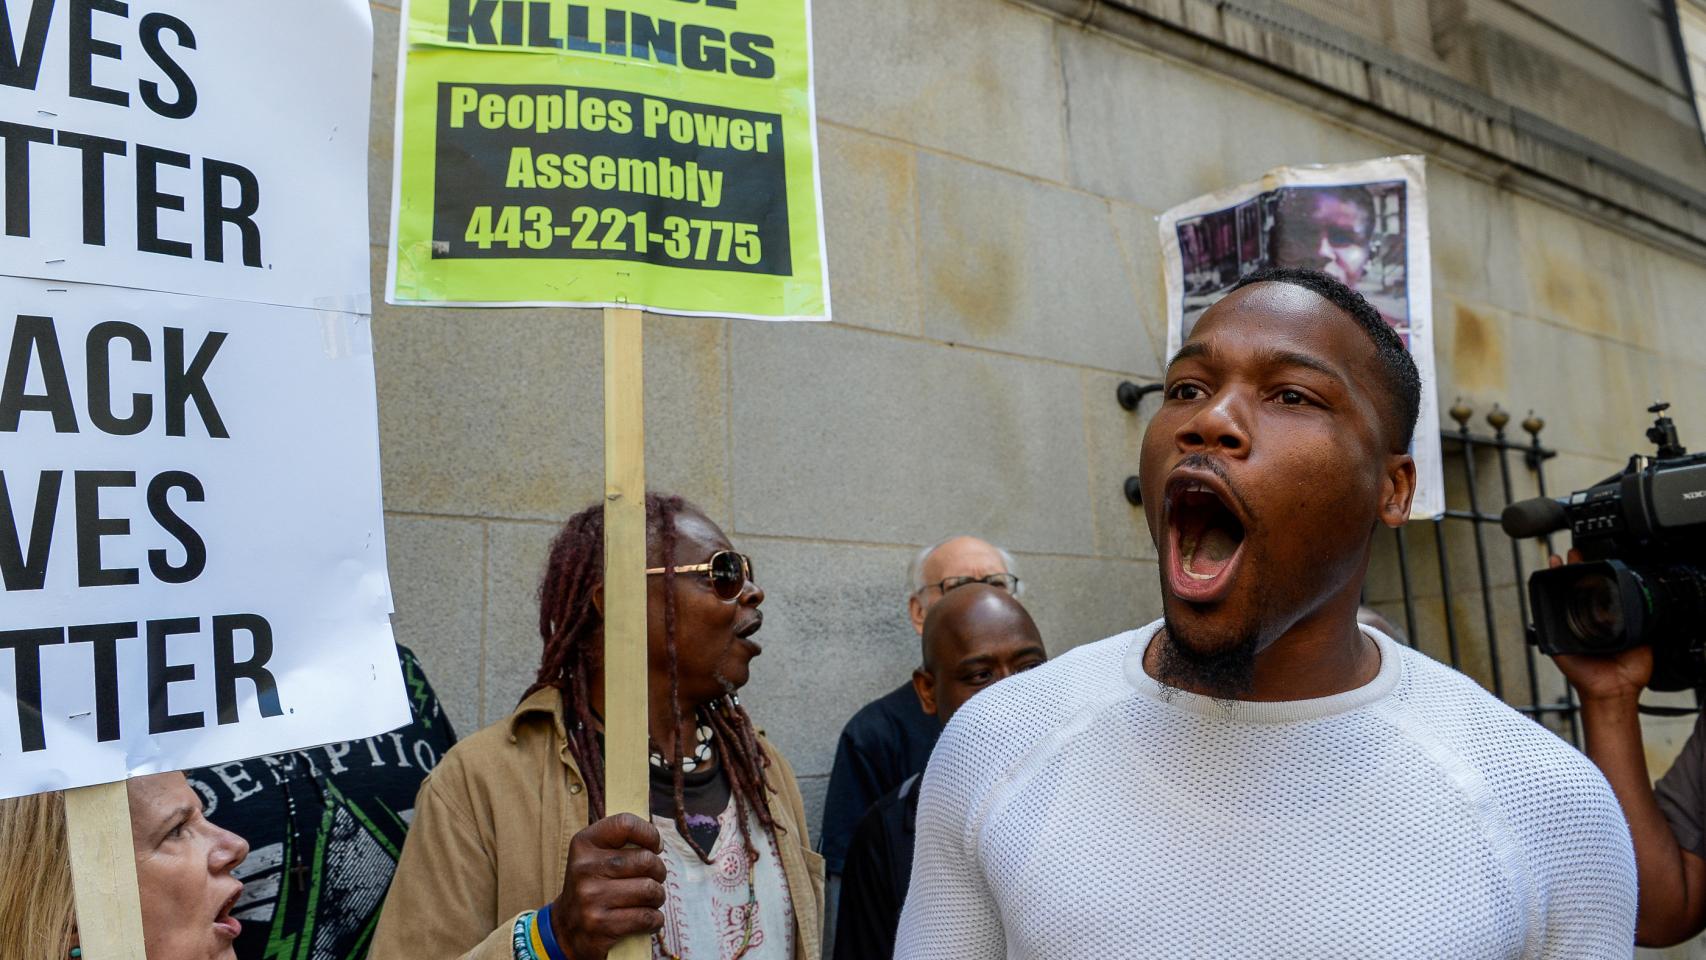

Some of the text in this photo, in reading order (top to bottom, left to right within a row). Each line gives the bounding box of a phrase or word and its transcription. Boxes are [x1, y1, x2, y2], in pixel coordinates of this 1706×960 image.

[447, 0, 775, 79] KILLINGS
[450, 86, 773, 153] Peoples Power
[505, 146, 723, 208] Assembly
[464, 205, 762, 265] 443-221-3775
[0, 314, 230, 439] ACK
[0, 470, 207, 592] VES
